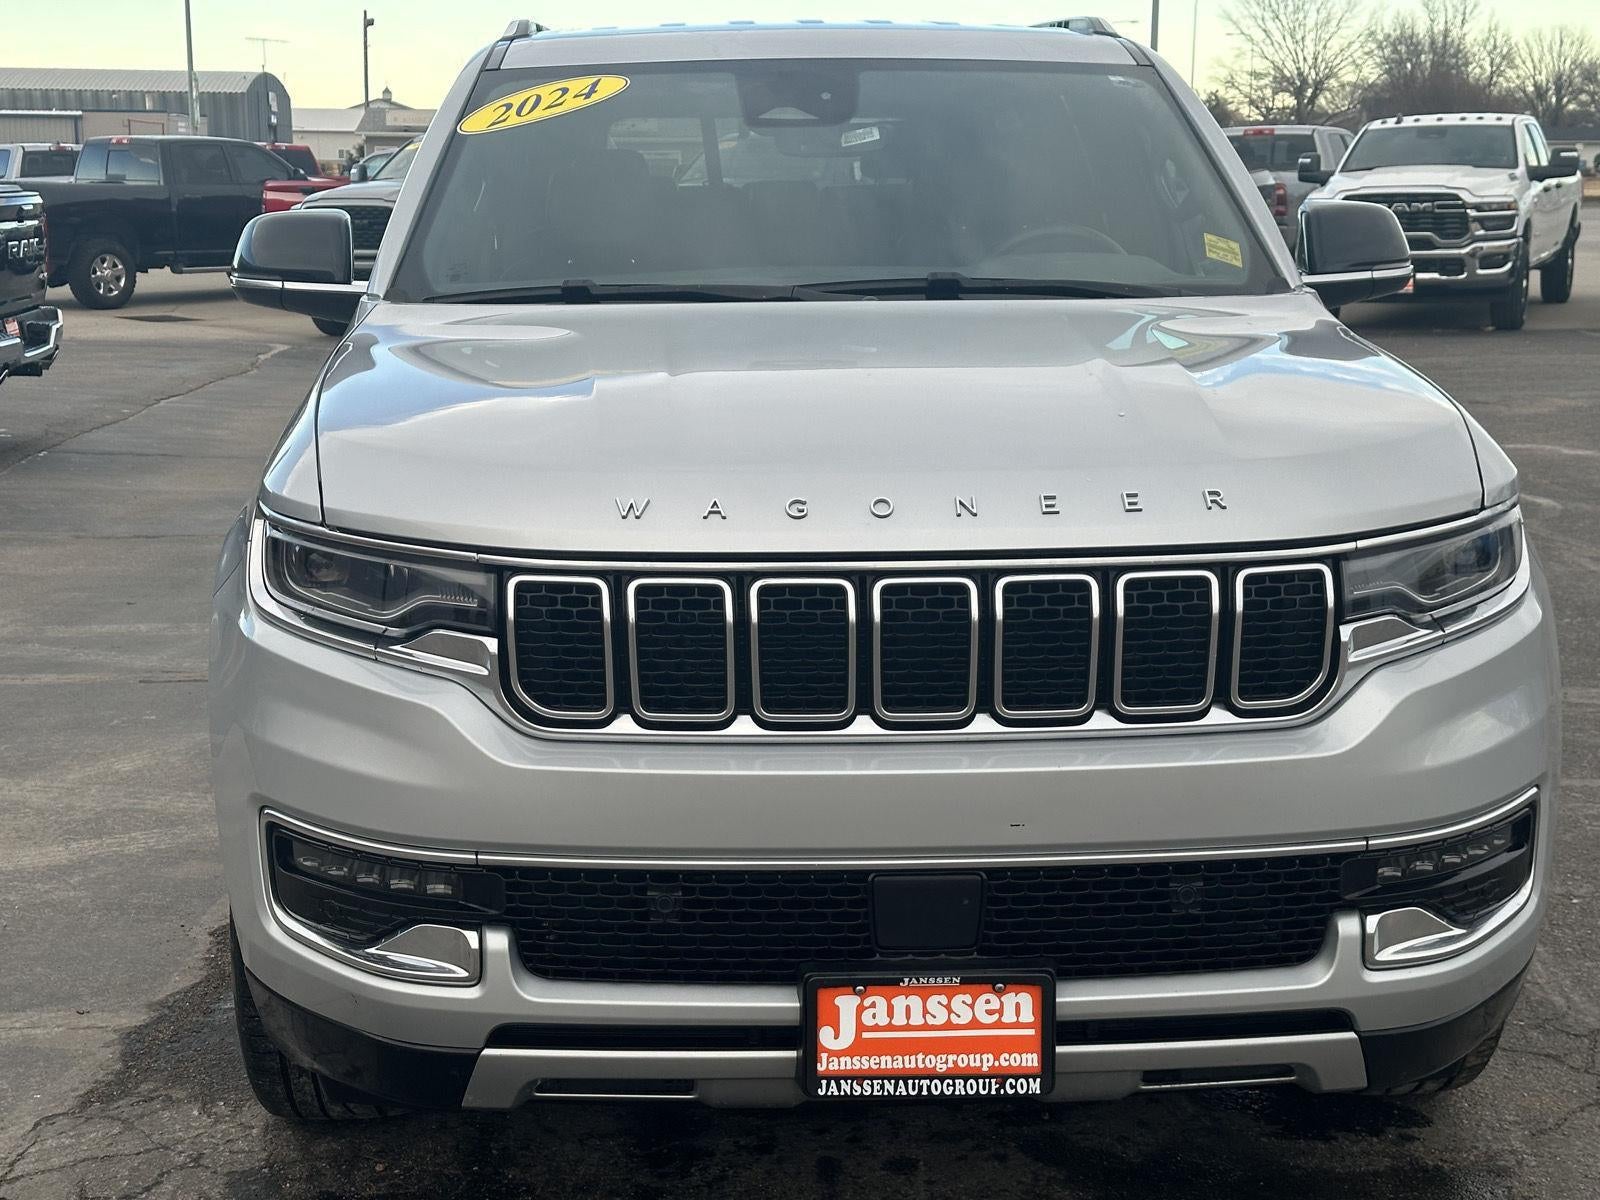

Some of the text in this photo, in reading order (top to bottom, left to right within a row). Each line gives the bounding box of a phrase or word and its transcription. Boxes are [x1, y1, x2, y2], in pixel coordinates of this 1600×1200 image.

[486, 78, 602, 128] 2024
[1381, 202, 1433, 212] AM
[615, 488, 1227, 520] WAGONEER
[900, 977, 961, 986] JANSSEN
[819, 991, 1035, 1050] Janssen
[817, 1052, 1039, 1072] Janssenautogroup.com
[817, 1078, 1041, 1096] JANSSENAUTOGROUP.COM
